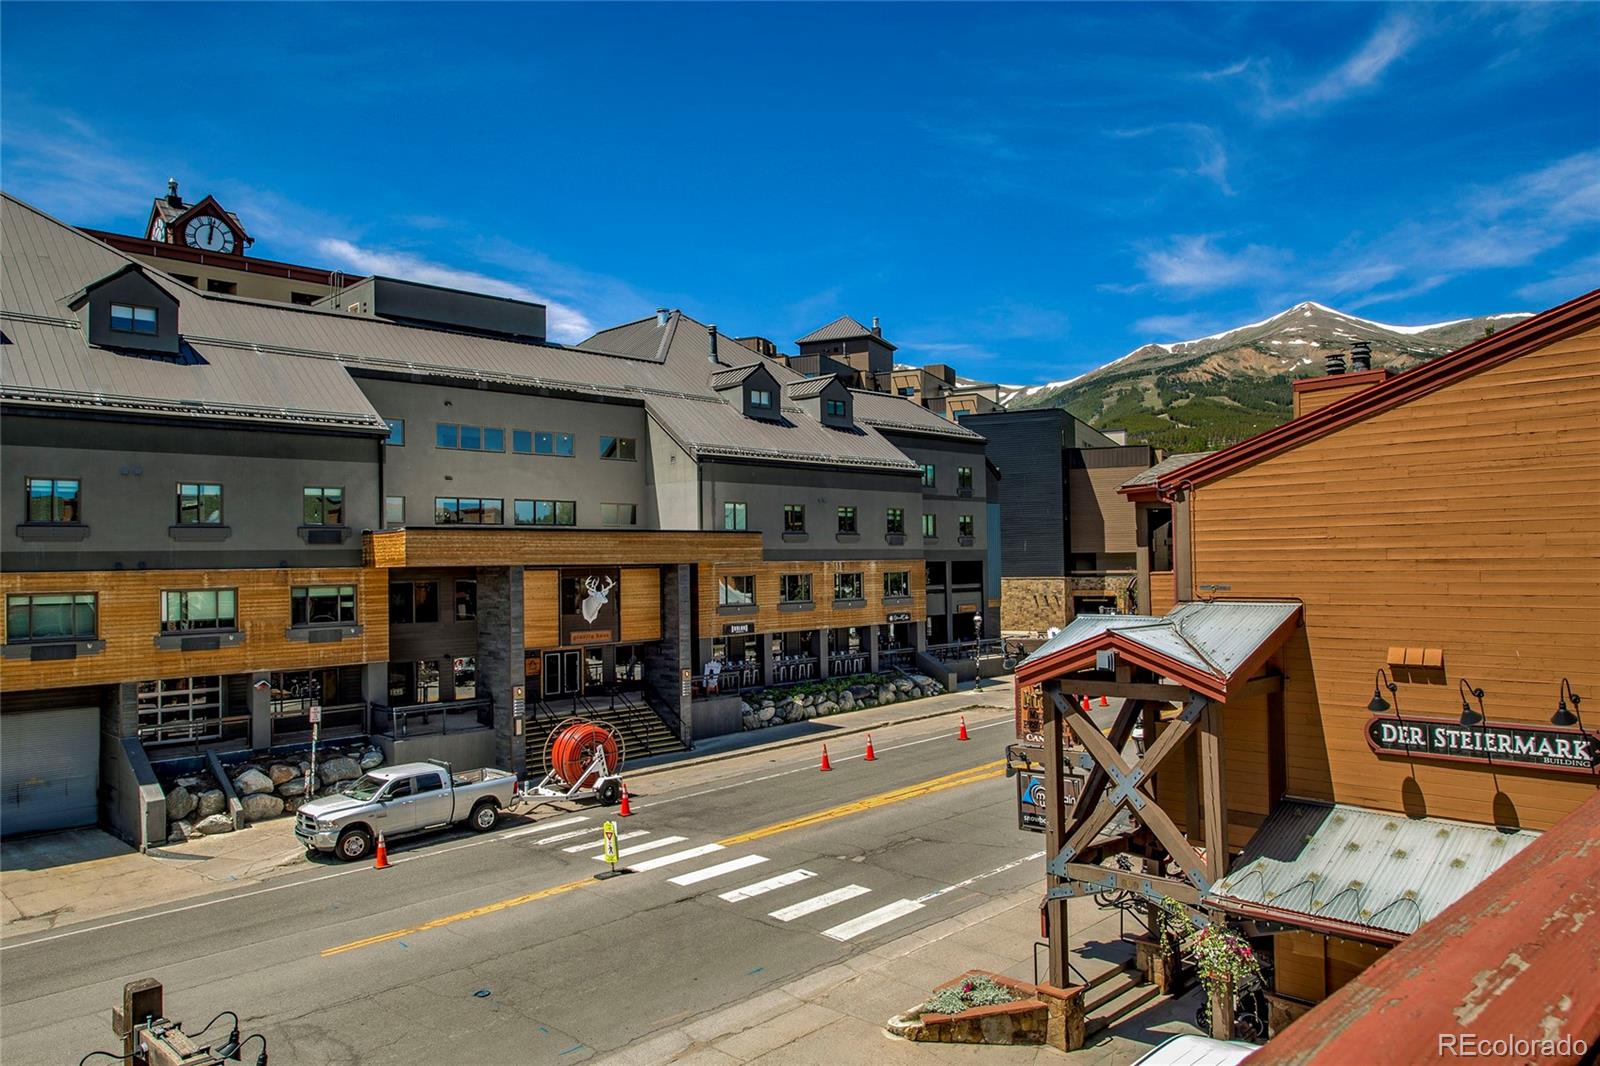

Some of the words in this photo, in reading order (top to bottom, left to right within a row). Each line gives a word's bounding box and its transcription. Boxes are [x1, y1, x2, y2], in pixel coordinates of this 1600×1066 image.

[1381, 723, 1426, 746] DER
[1434, 728, 1593, 761] STEIERMARK
[1543, 757, 1591, 768] BUILDING
